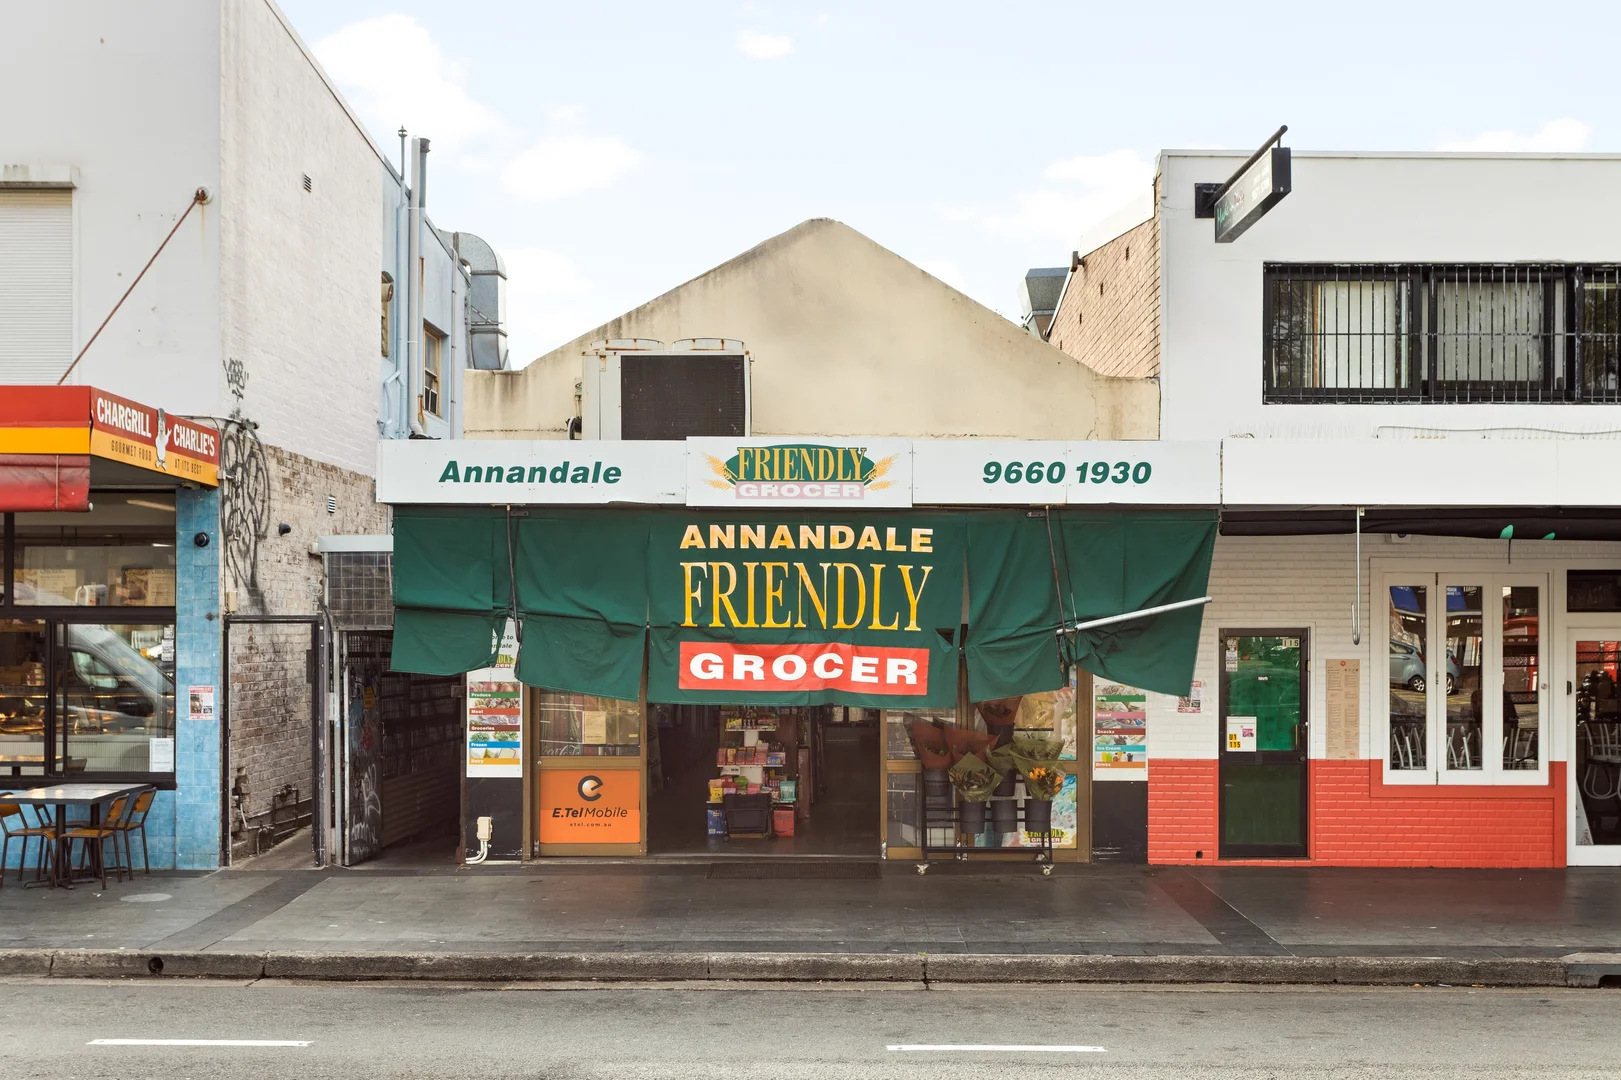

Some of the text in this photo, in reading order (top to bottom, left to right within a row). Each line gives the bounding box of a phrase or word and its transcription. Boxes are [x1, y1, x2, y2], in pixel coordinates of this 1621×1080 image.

[97, 397, 215, 457] CHARGRILL CHARLIE'S
[111, 440, 136, 457] GOURMET
[139, 448, 152, 461] FOOD
[737, 447, 867, 481] FRIENDLY
[438, 461, 622, 484] Annandale
[983, 461, 1152, 484] 9660 1930
[738, 484, 861, 497] GROCER
[680, 524, 934, 553] ANNANDALE
[680, 561, 934, 631] FRIENDLY
[690, 652, 918, 685] GROCER
